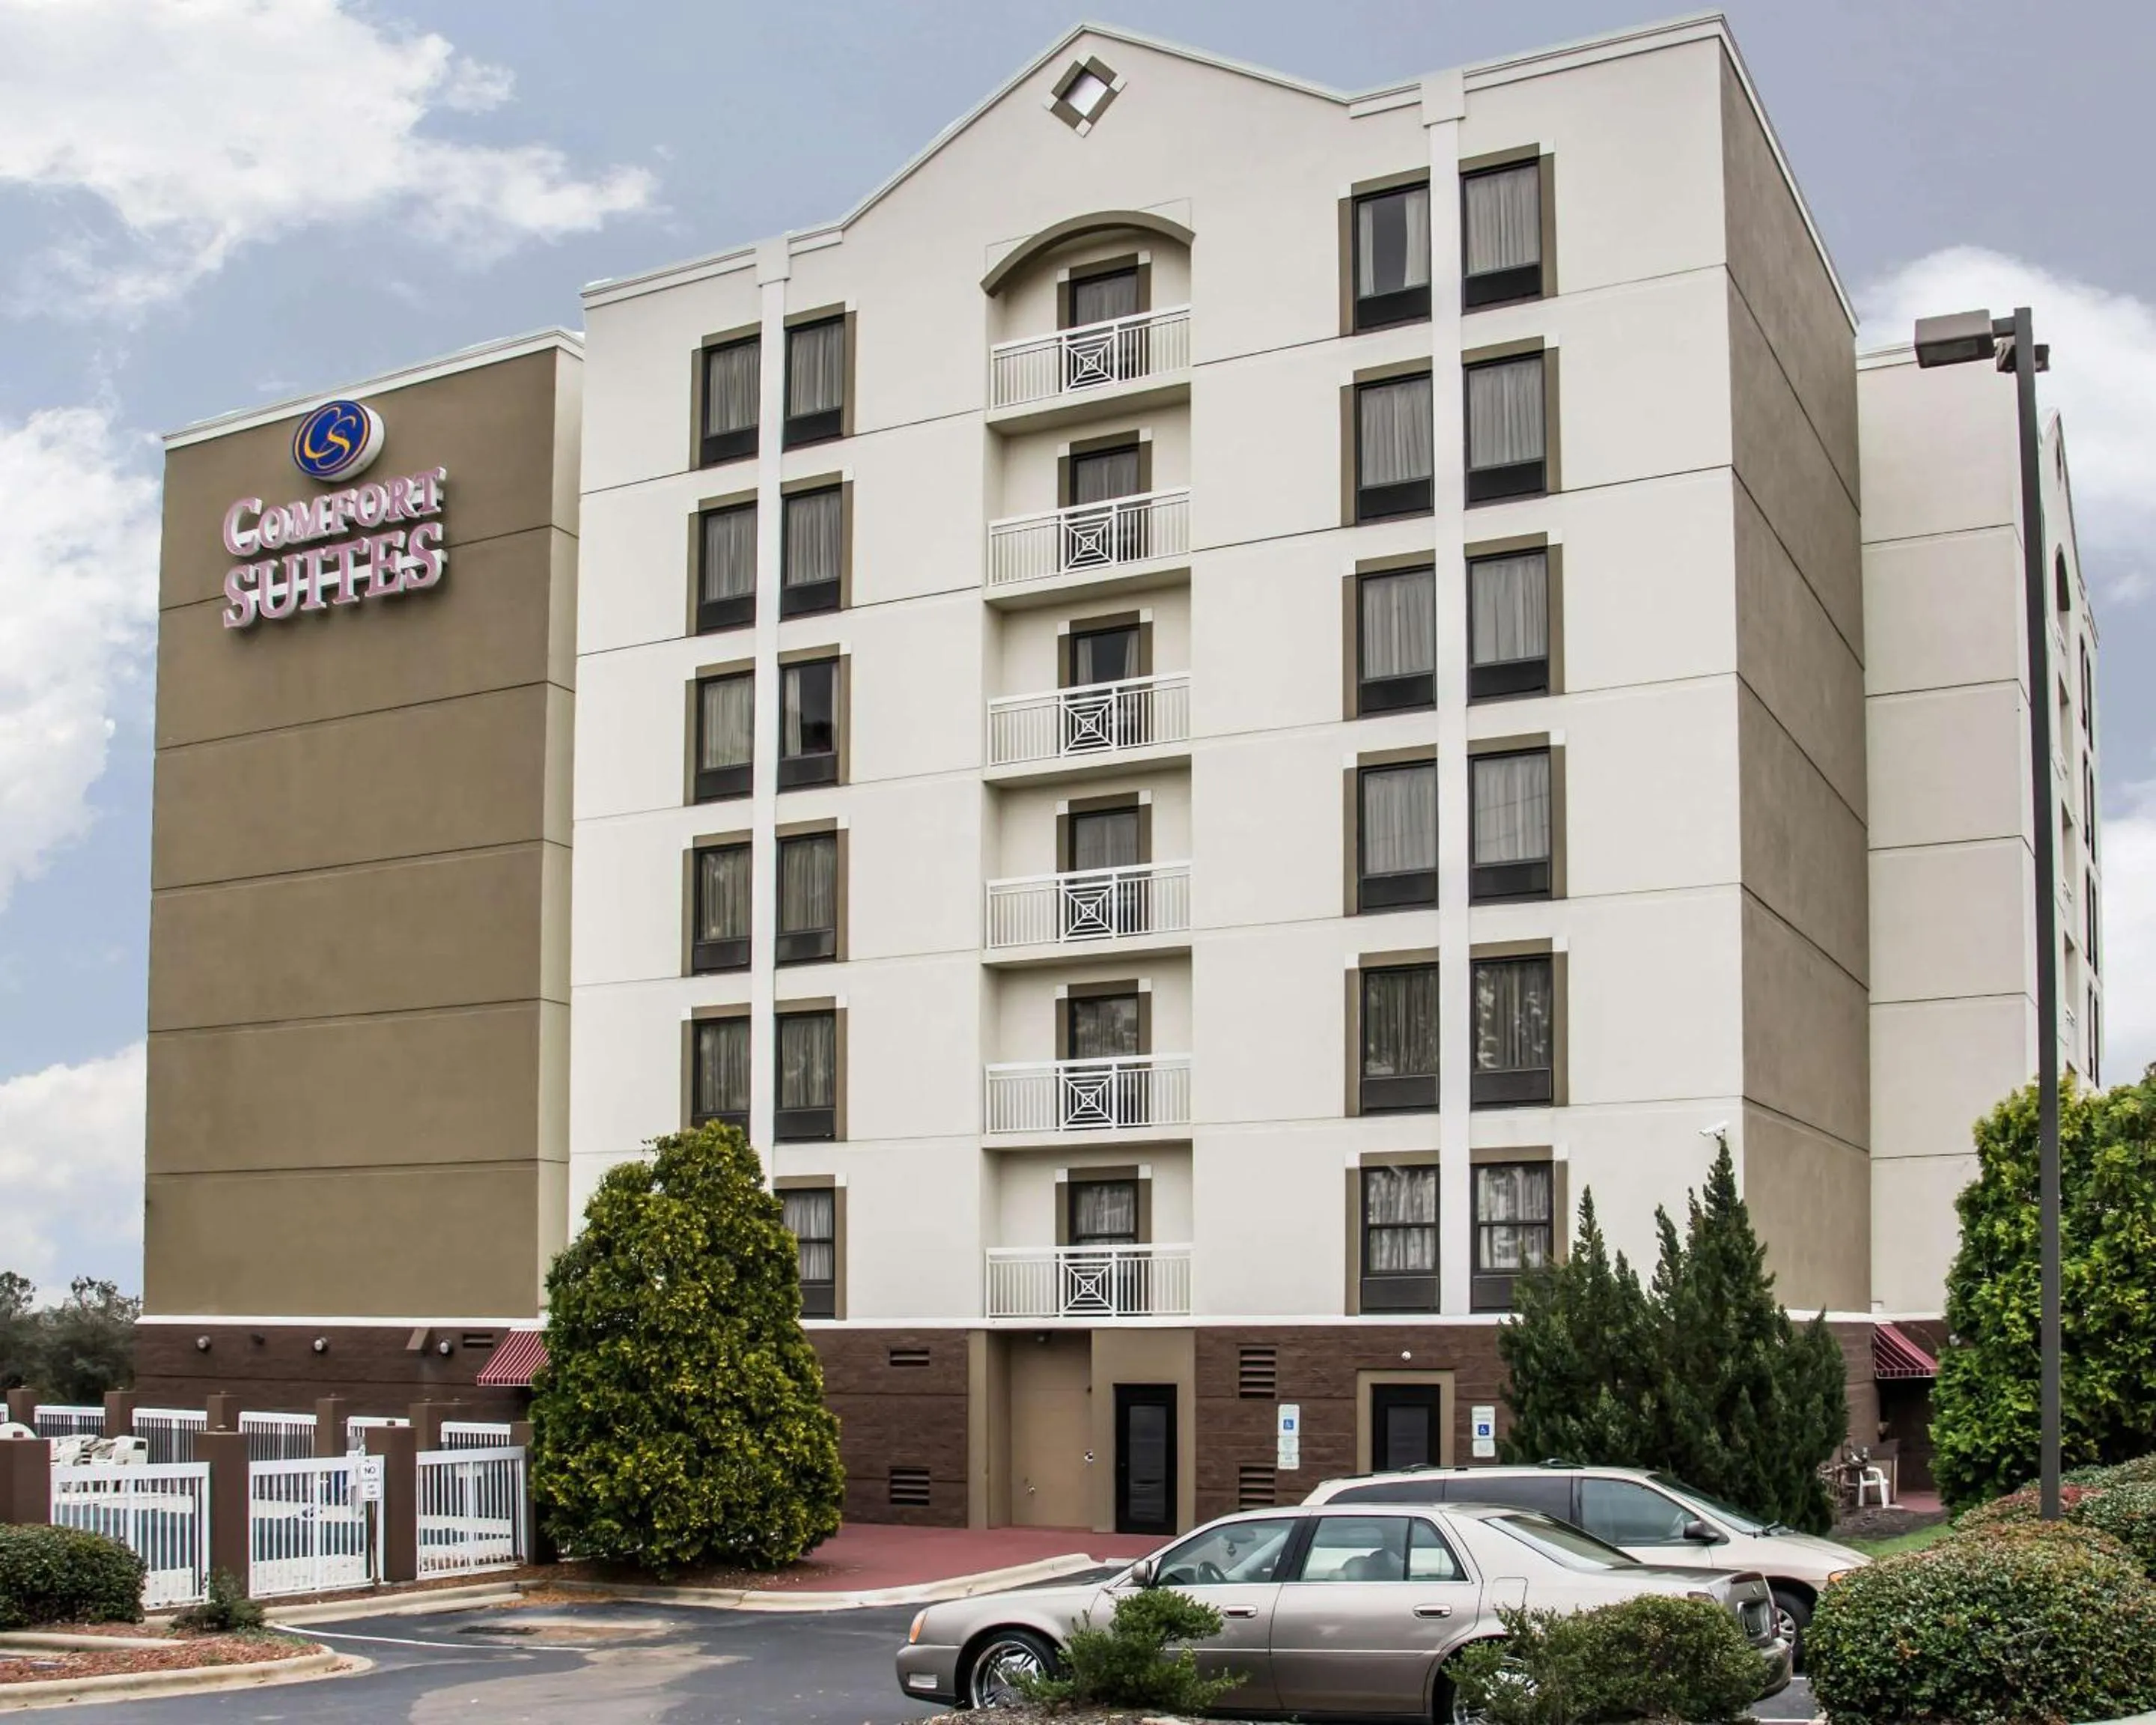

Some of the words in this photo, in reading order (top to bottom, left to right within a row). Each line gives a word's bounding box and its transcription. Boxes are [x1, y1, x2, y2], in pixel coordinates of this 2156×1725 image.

[223, 466, 447, 557] COMFORT
[222, 522, 448, 629] SUITES
[365, 1466, 376, 1474] NO
